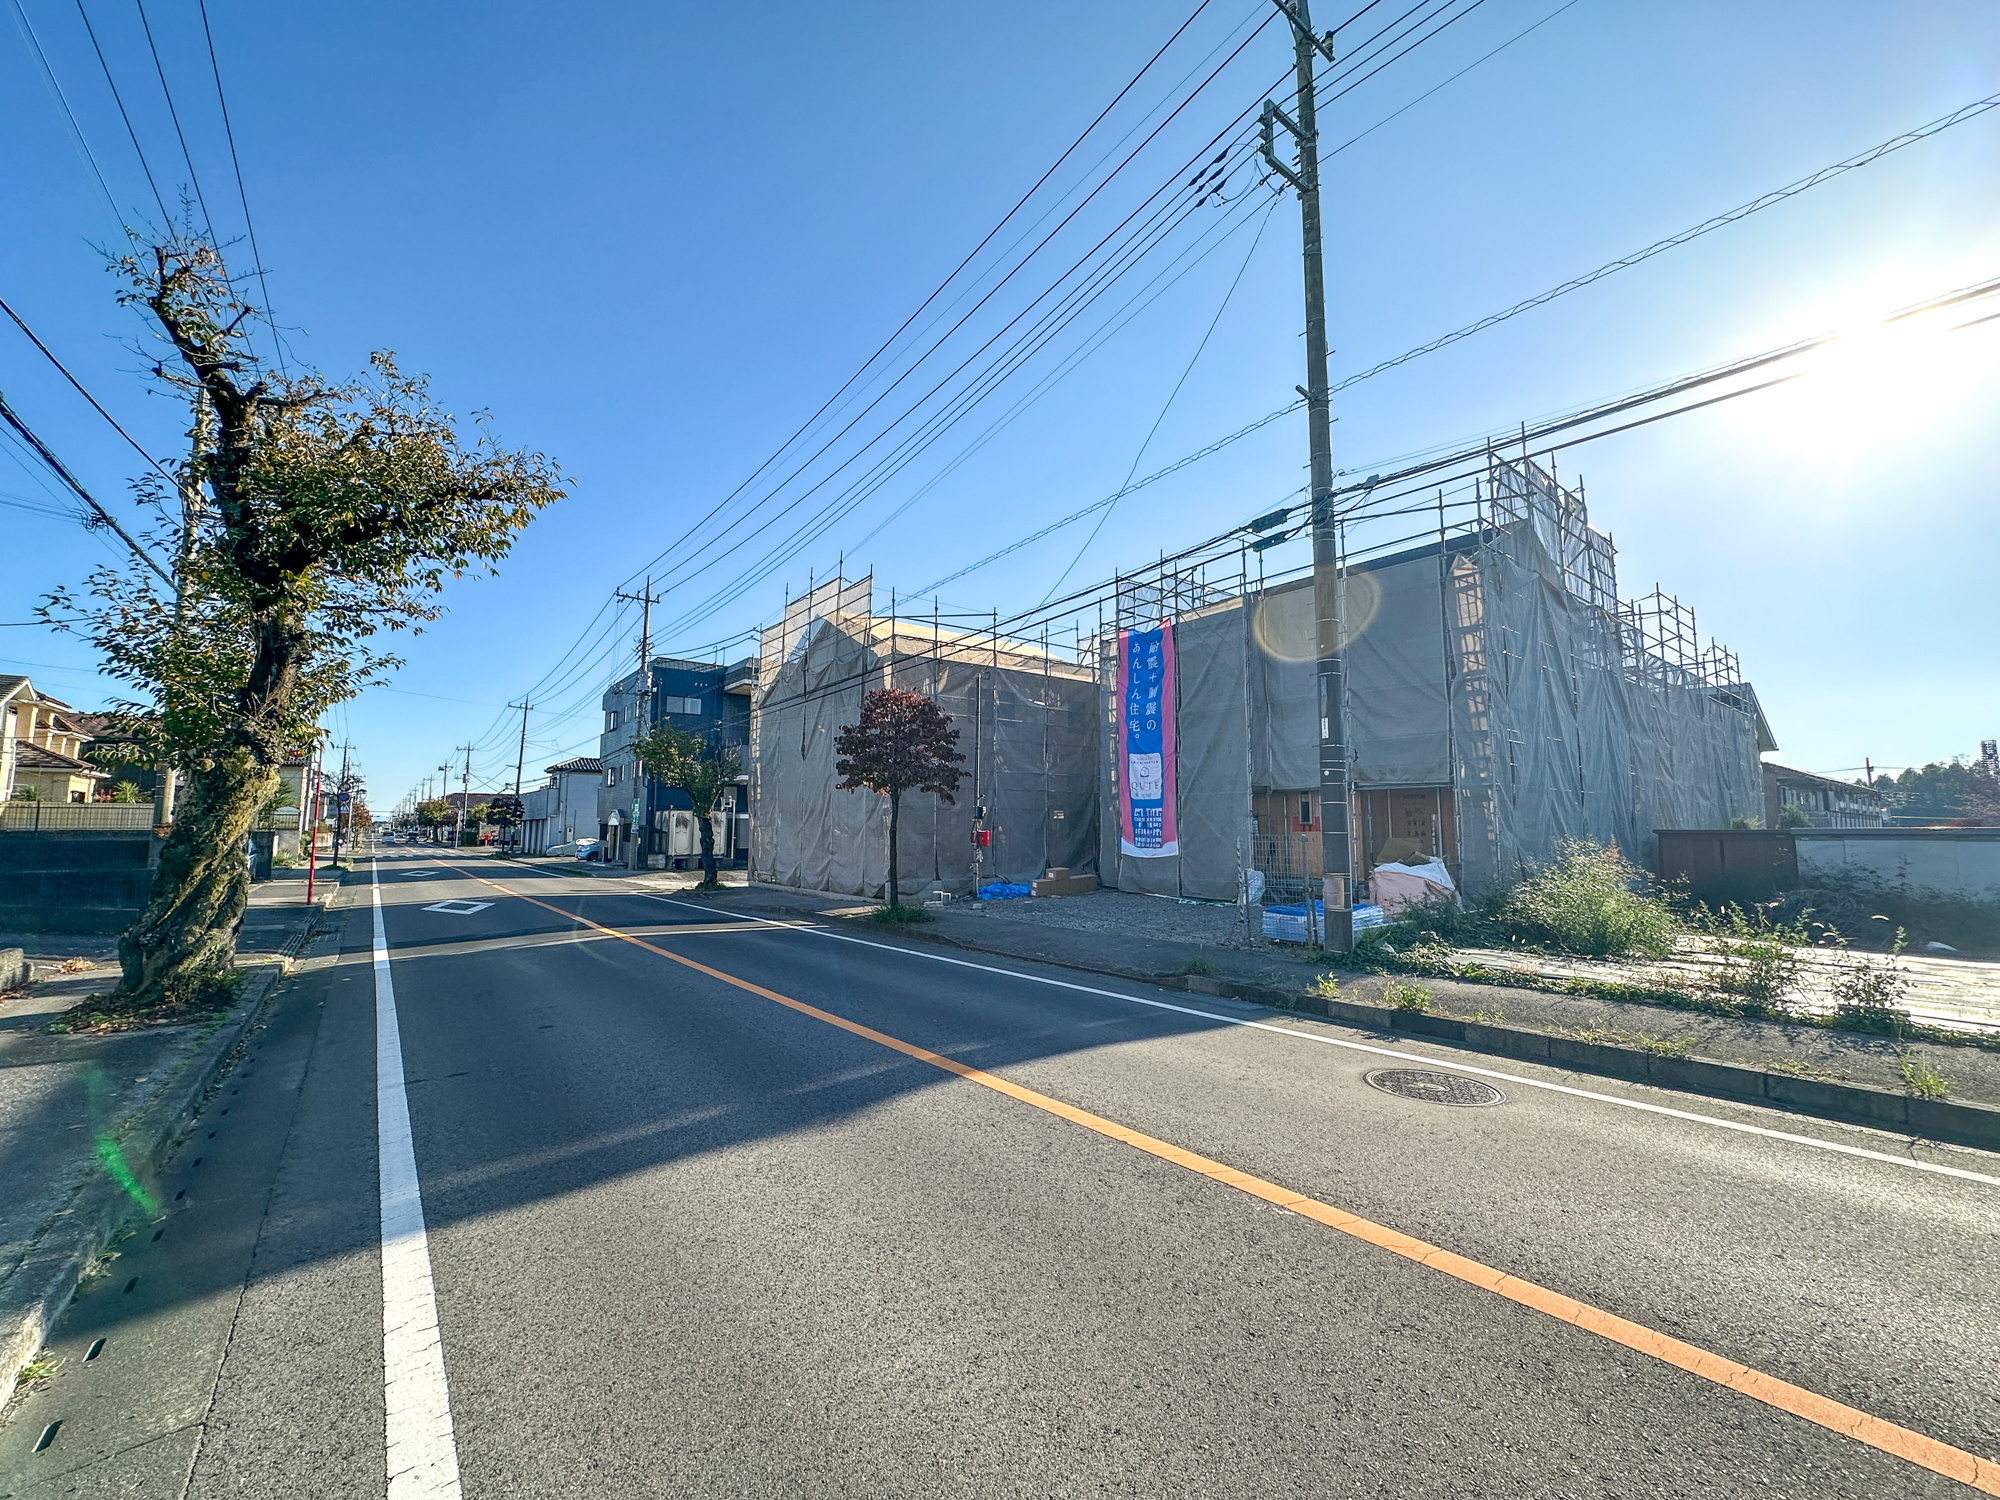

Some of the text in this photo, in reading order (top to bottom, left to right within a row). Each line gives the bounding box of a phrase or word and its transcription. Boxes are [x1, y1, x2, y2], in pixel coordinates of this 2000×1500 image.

[1129, 643, 1142, 739] あんしん住宅。
